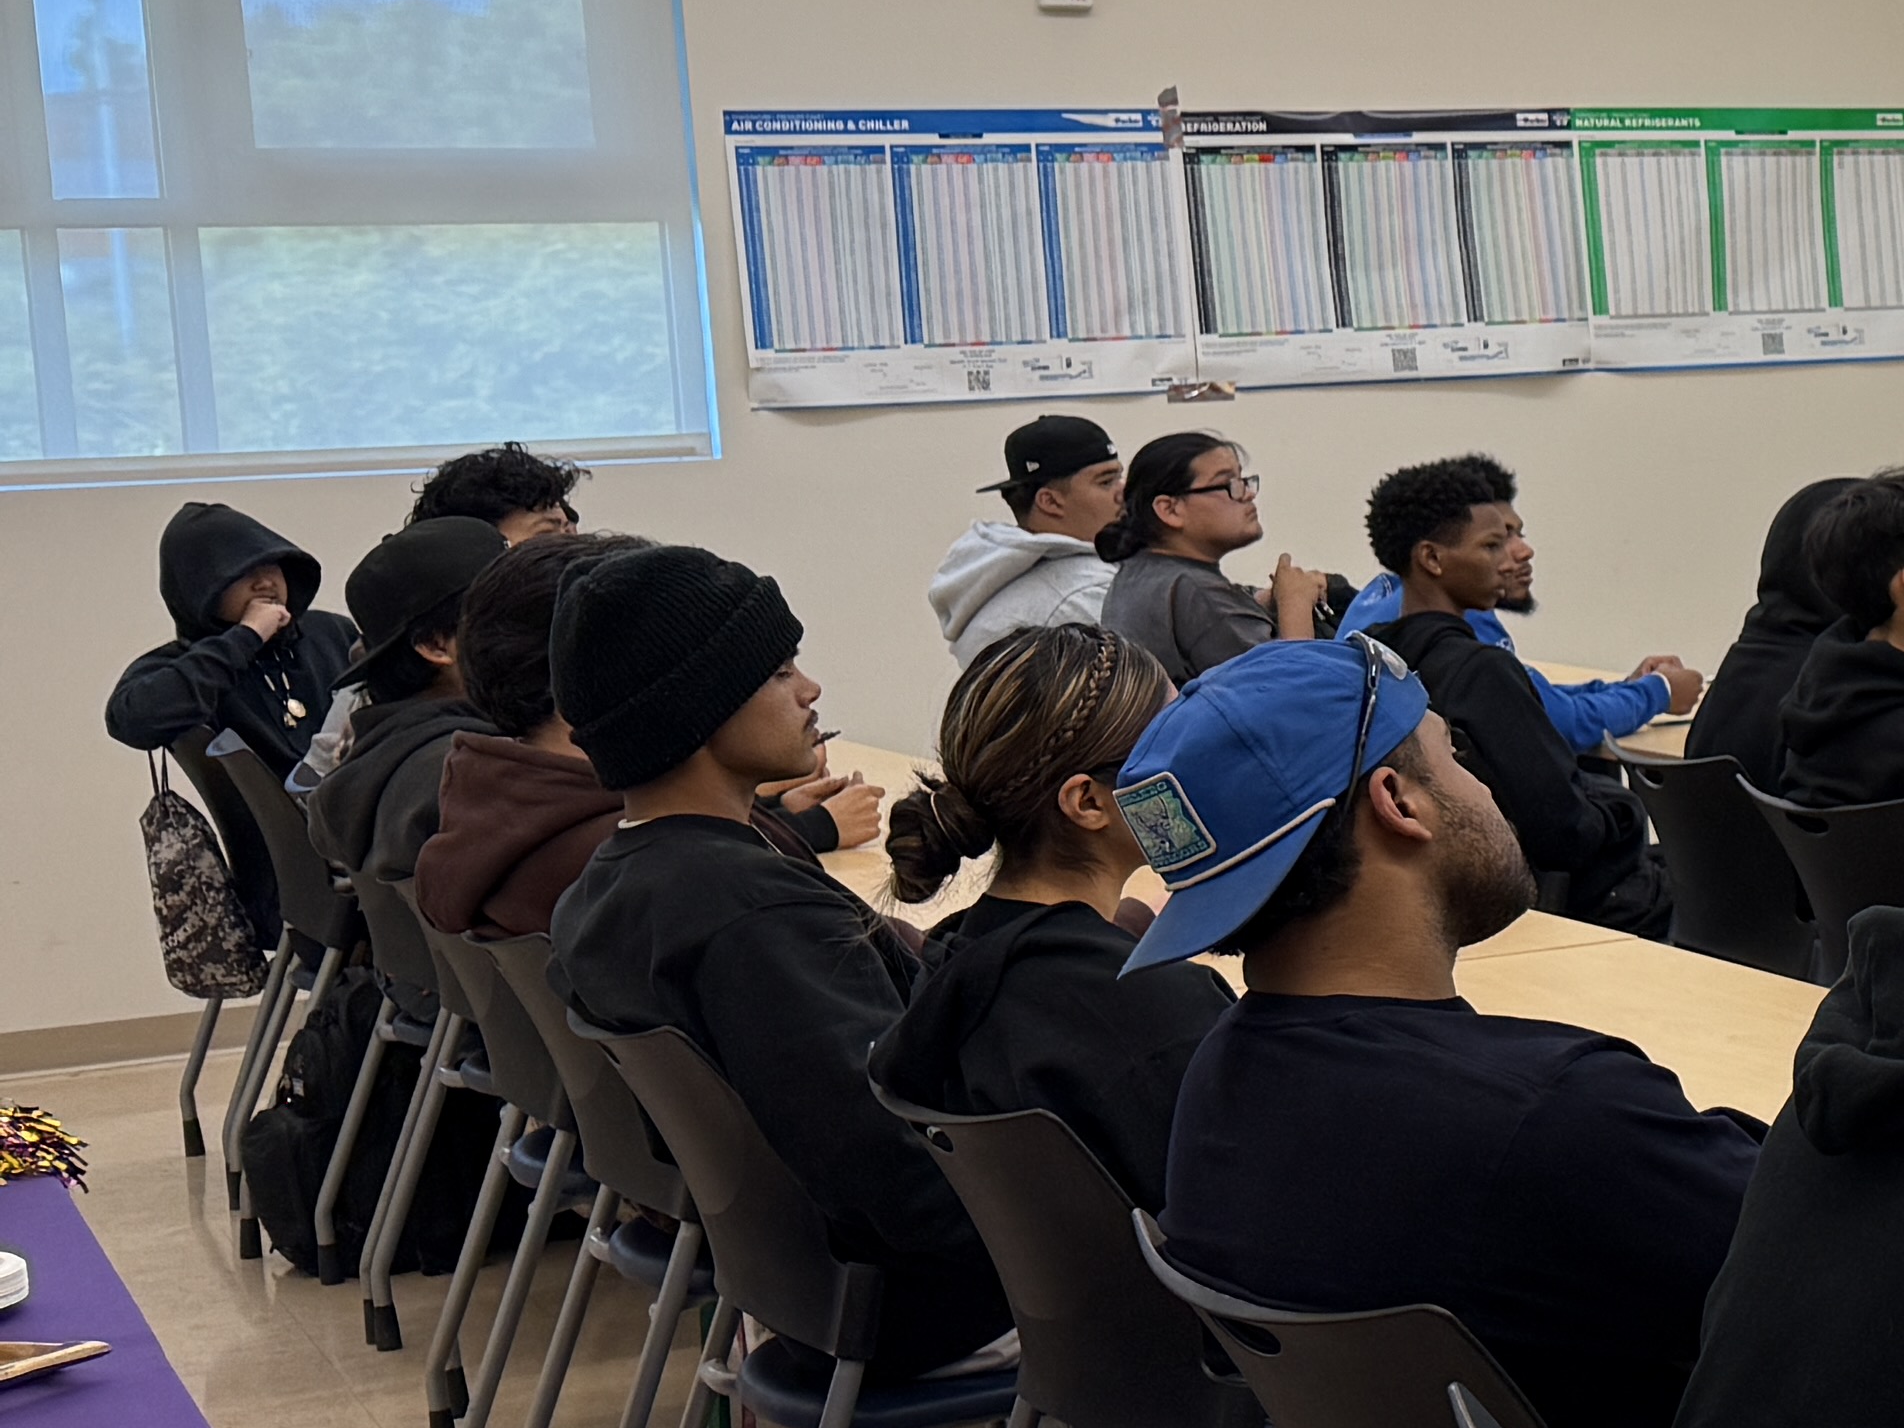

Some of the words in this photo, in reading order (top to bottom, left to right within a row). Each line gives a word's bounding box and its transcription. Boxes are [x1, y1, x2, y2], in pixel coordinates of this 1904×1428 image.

[731, 119, 753, 131] AIR
[755, 119, 844, 131] CONDITIONING
[847, 119, 856, 131] &
[858, 119, 910, 131] CHILLER
[1575, 118, 1621, 127] NATURAL
[1624, 118, 1701, 128] REFRIGERANTS
